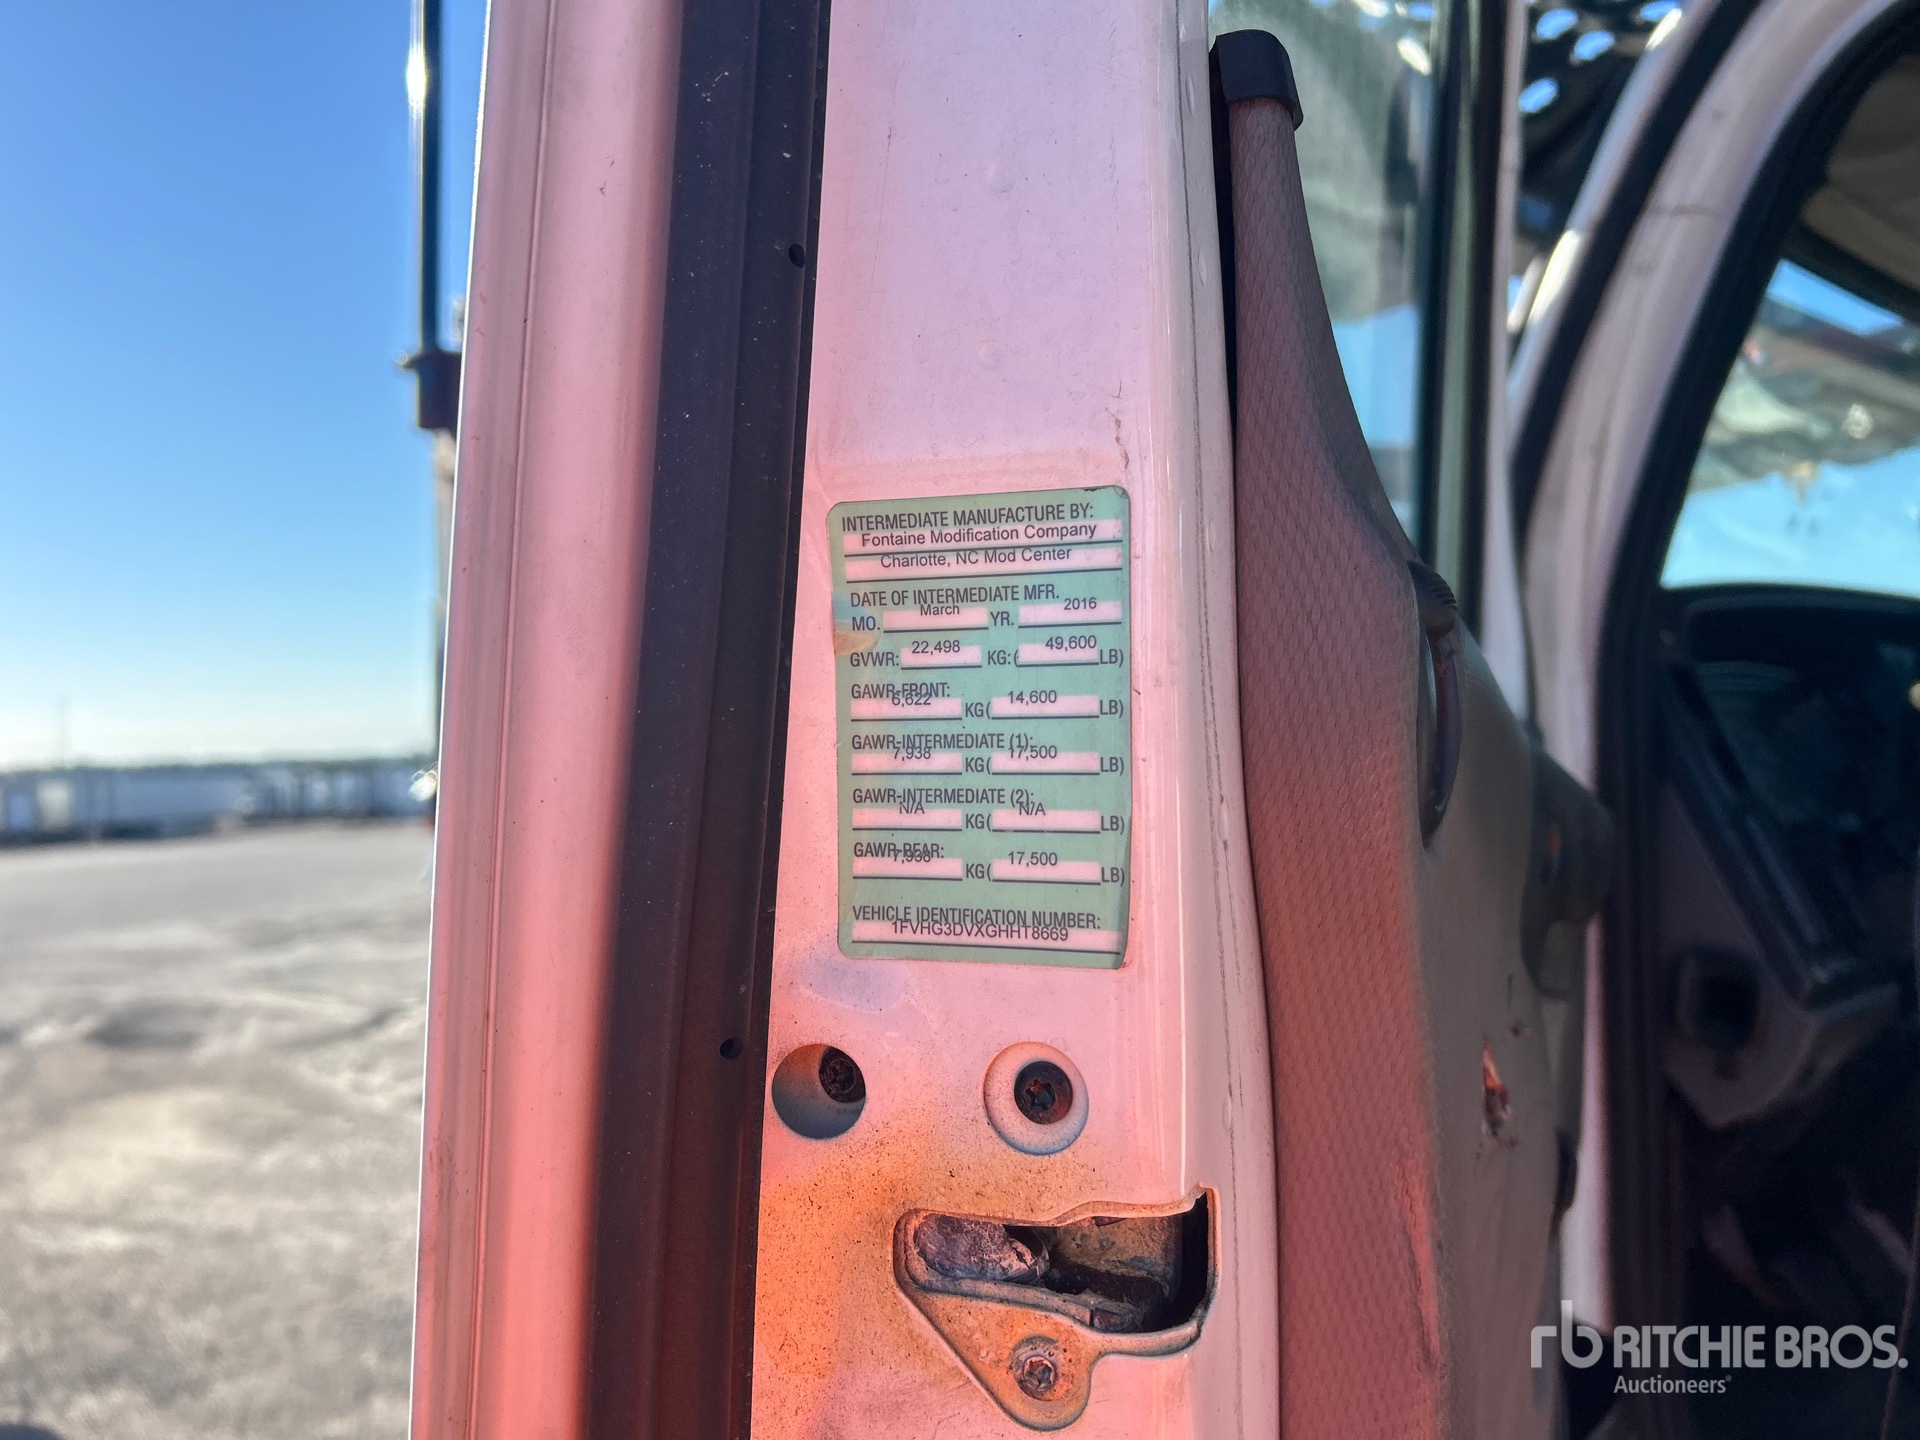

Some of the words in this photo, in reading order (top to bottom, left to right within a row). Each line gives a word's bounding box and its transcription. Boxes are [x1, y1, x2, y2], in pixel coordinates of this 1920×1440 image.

[842, 511, 949, 532] INTERMEDIATE
[953, 504, 1065, 527] MANUFACTURE
[1070, 502, 1094, 519] BY:
[861, 532, 925, 547] Fontaine
[930, 526, 1019, 544] Modification
[1024, 523, 1097, 540] Company
[880, 553, 951, 568] Charlotte,
[956, 550, 979, 565] NC
[984, 548, 1016, 564] Mod
[1021, 547, 1071, 562] Center
[850, 591, 887, 607] DATE
[891, 590, 909, 605] OF
[913, 586, 1019, 605] INTERMEDIATE
[1023, 583, 1060, 600] MFR.
[852, 616, 881, 631] MO.
[920, 603, 960, 616] March
[990, 611, 1014, 627] YR.
[1063, 597, 1097, 611] 2016
[850, 651, 899, 667] GVWR:
[911, 640, 960, 655] 22,498
[1045, 635, 1097, 651] 49,600
[891, 693, 931, 707] 6,622
[1007, 690, 1057, 705] 14,600
[852, 734, 1005, 750] GAWR-INTERMEDIATE
[894, 747, 931, 761] 7,938
[1008, 745, 1057, 760] 17,500
[853, 788, 1005, 804] GAWR-INTERMEDIATE
[899, 802, 924, 814] N/A
[1018, 803, 1046, 816] N/A
[1008, 852, 1057, 866] 17,500
[852, 906, 911, 921] VEHICLE
[917, 907, 1028, 926] IDENTIFICATION
[1032, 911, 1100, 929] NUMBER:
[892, 921, 1069, 941] 1FVHG3DVXGHHT8669
